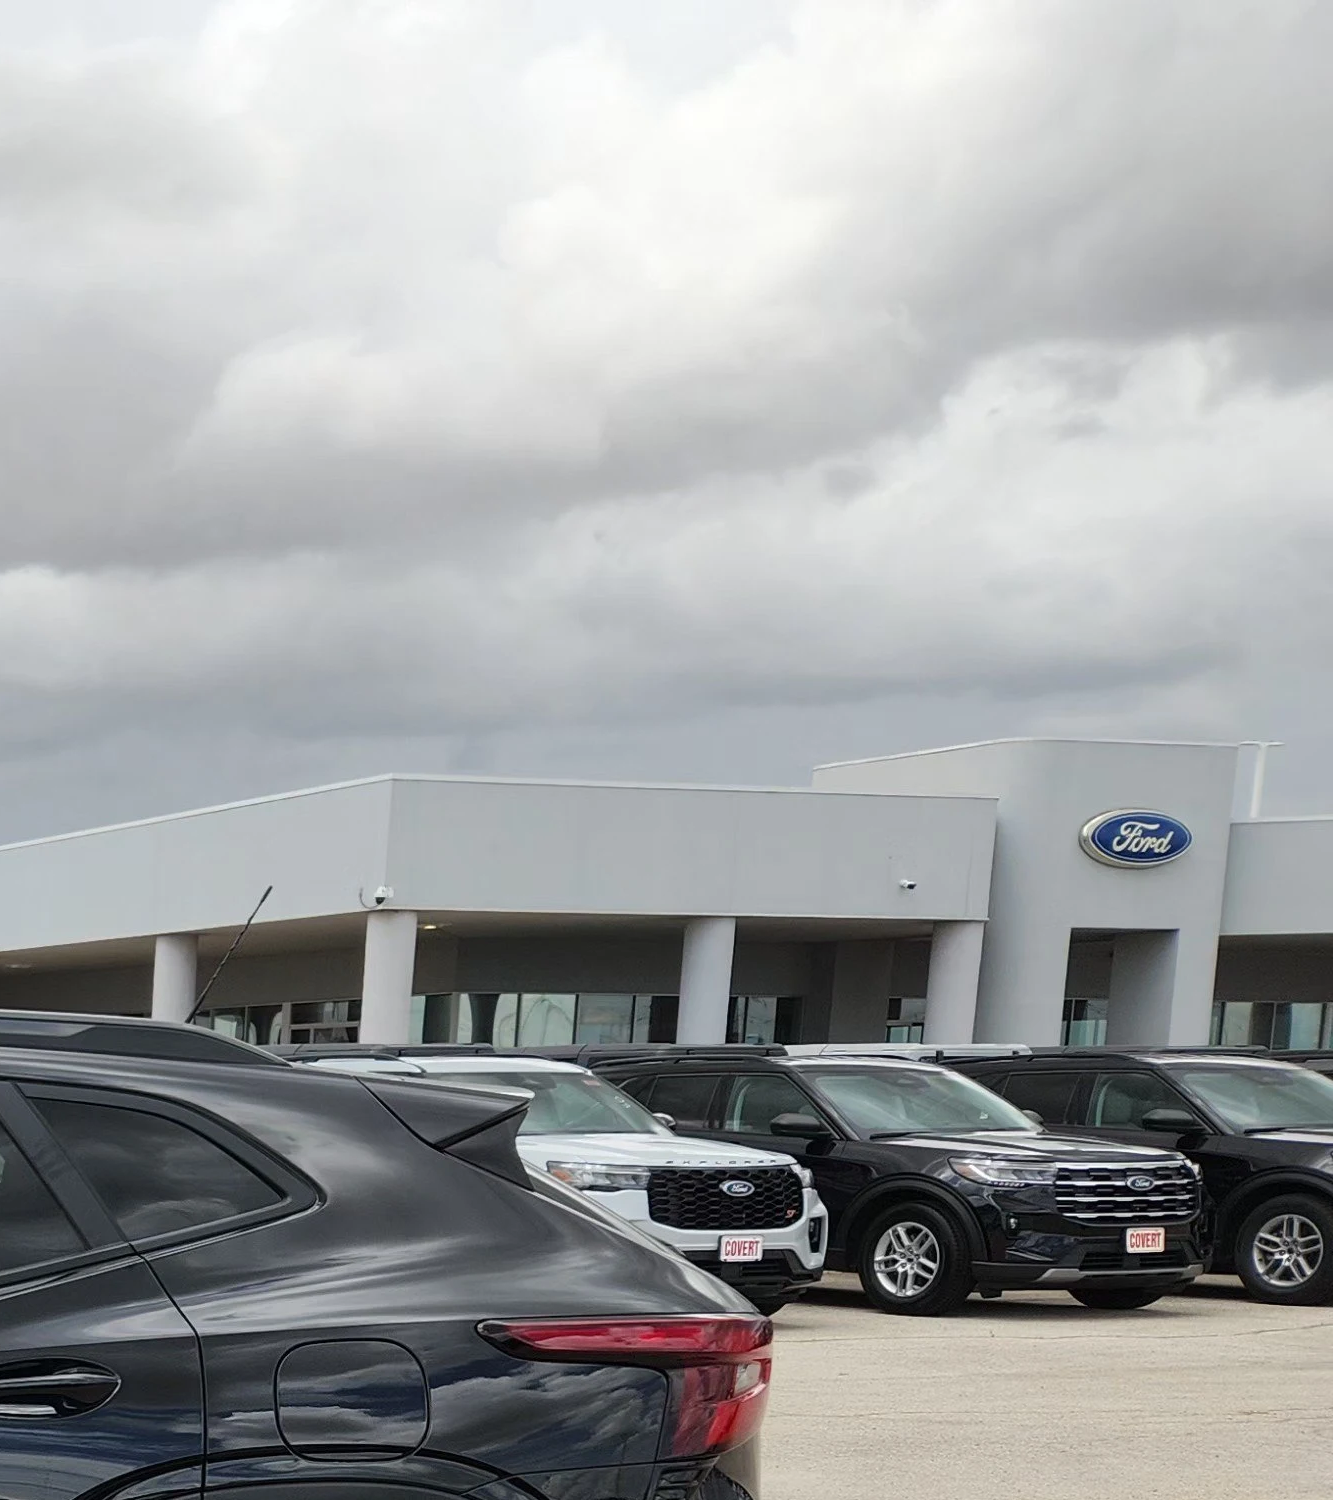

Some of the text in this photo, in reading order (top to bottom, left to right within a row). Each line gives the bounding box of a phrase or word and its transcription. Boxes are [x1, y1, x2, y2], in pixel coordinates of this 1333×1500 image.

[1112, 820, 1175, 854] Ford
[724, 1240, 761, 1257] COVERT
[1129, 1232, 1162, 1249] COVERT
